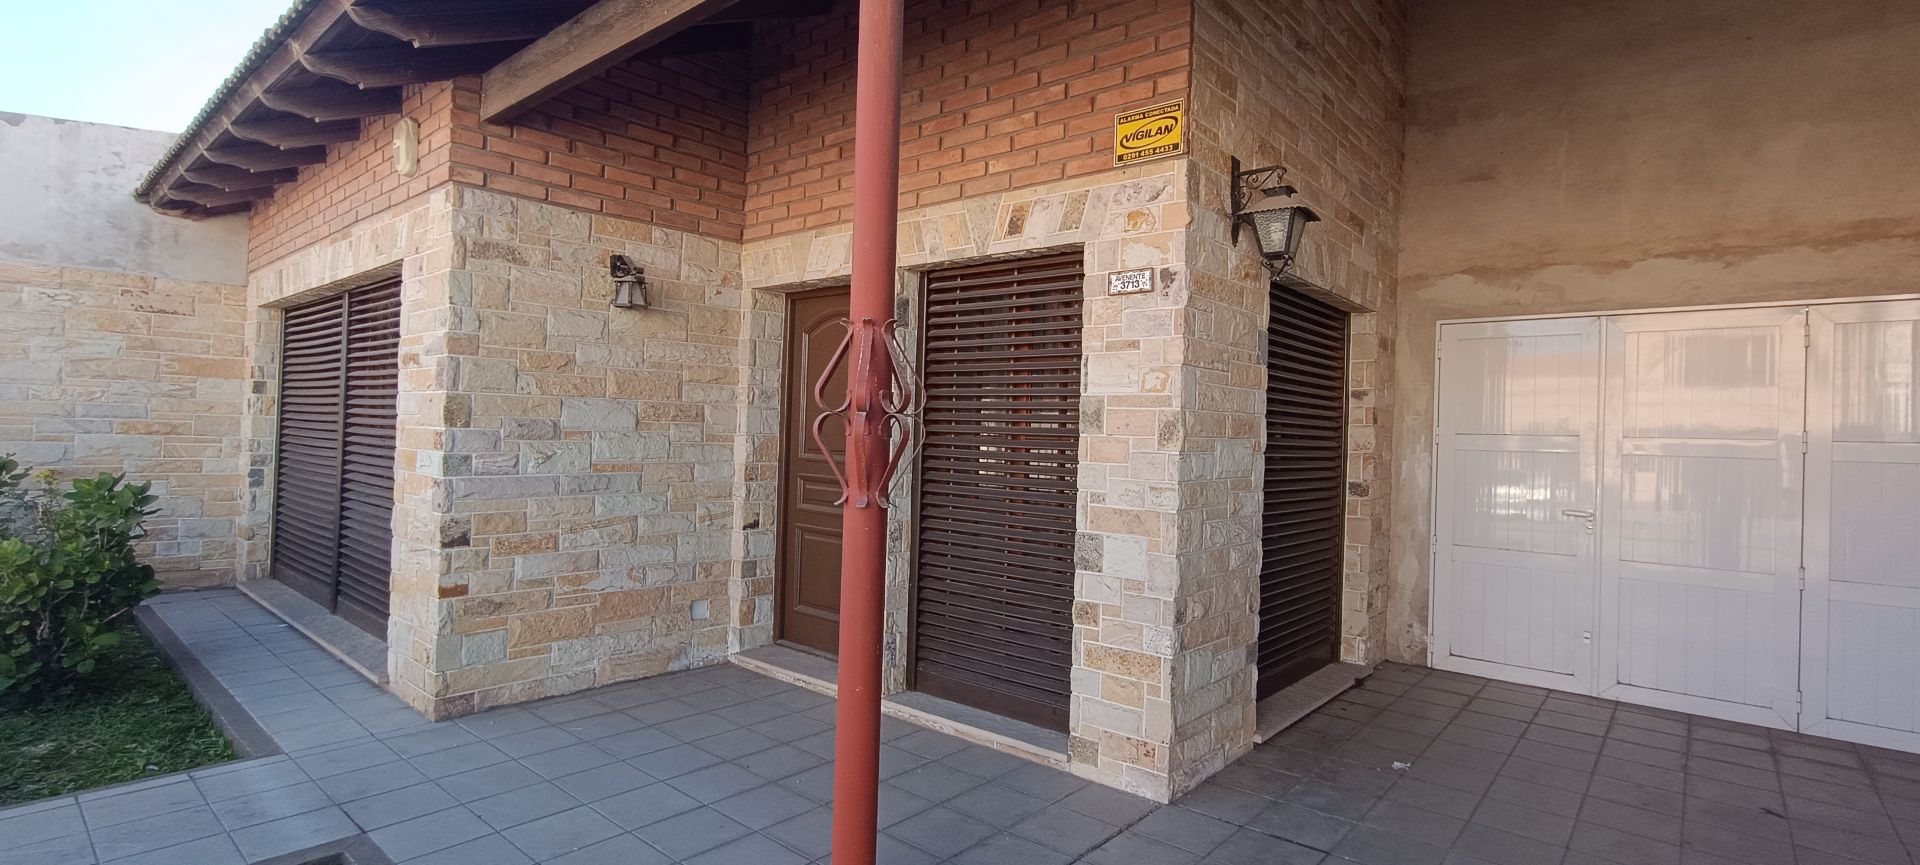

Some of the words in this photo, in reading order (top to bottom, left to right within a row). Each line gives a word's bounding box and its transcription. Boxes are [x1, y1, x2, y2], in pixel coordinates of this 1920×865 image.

[1144, 105, 1179, 118] CONECTADA
[1124, 124, 1174, 143] VIGILAN
[1140, 149, 1154, 157] 455
[1120, 279, 1140, 290] 3713
